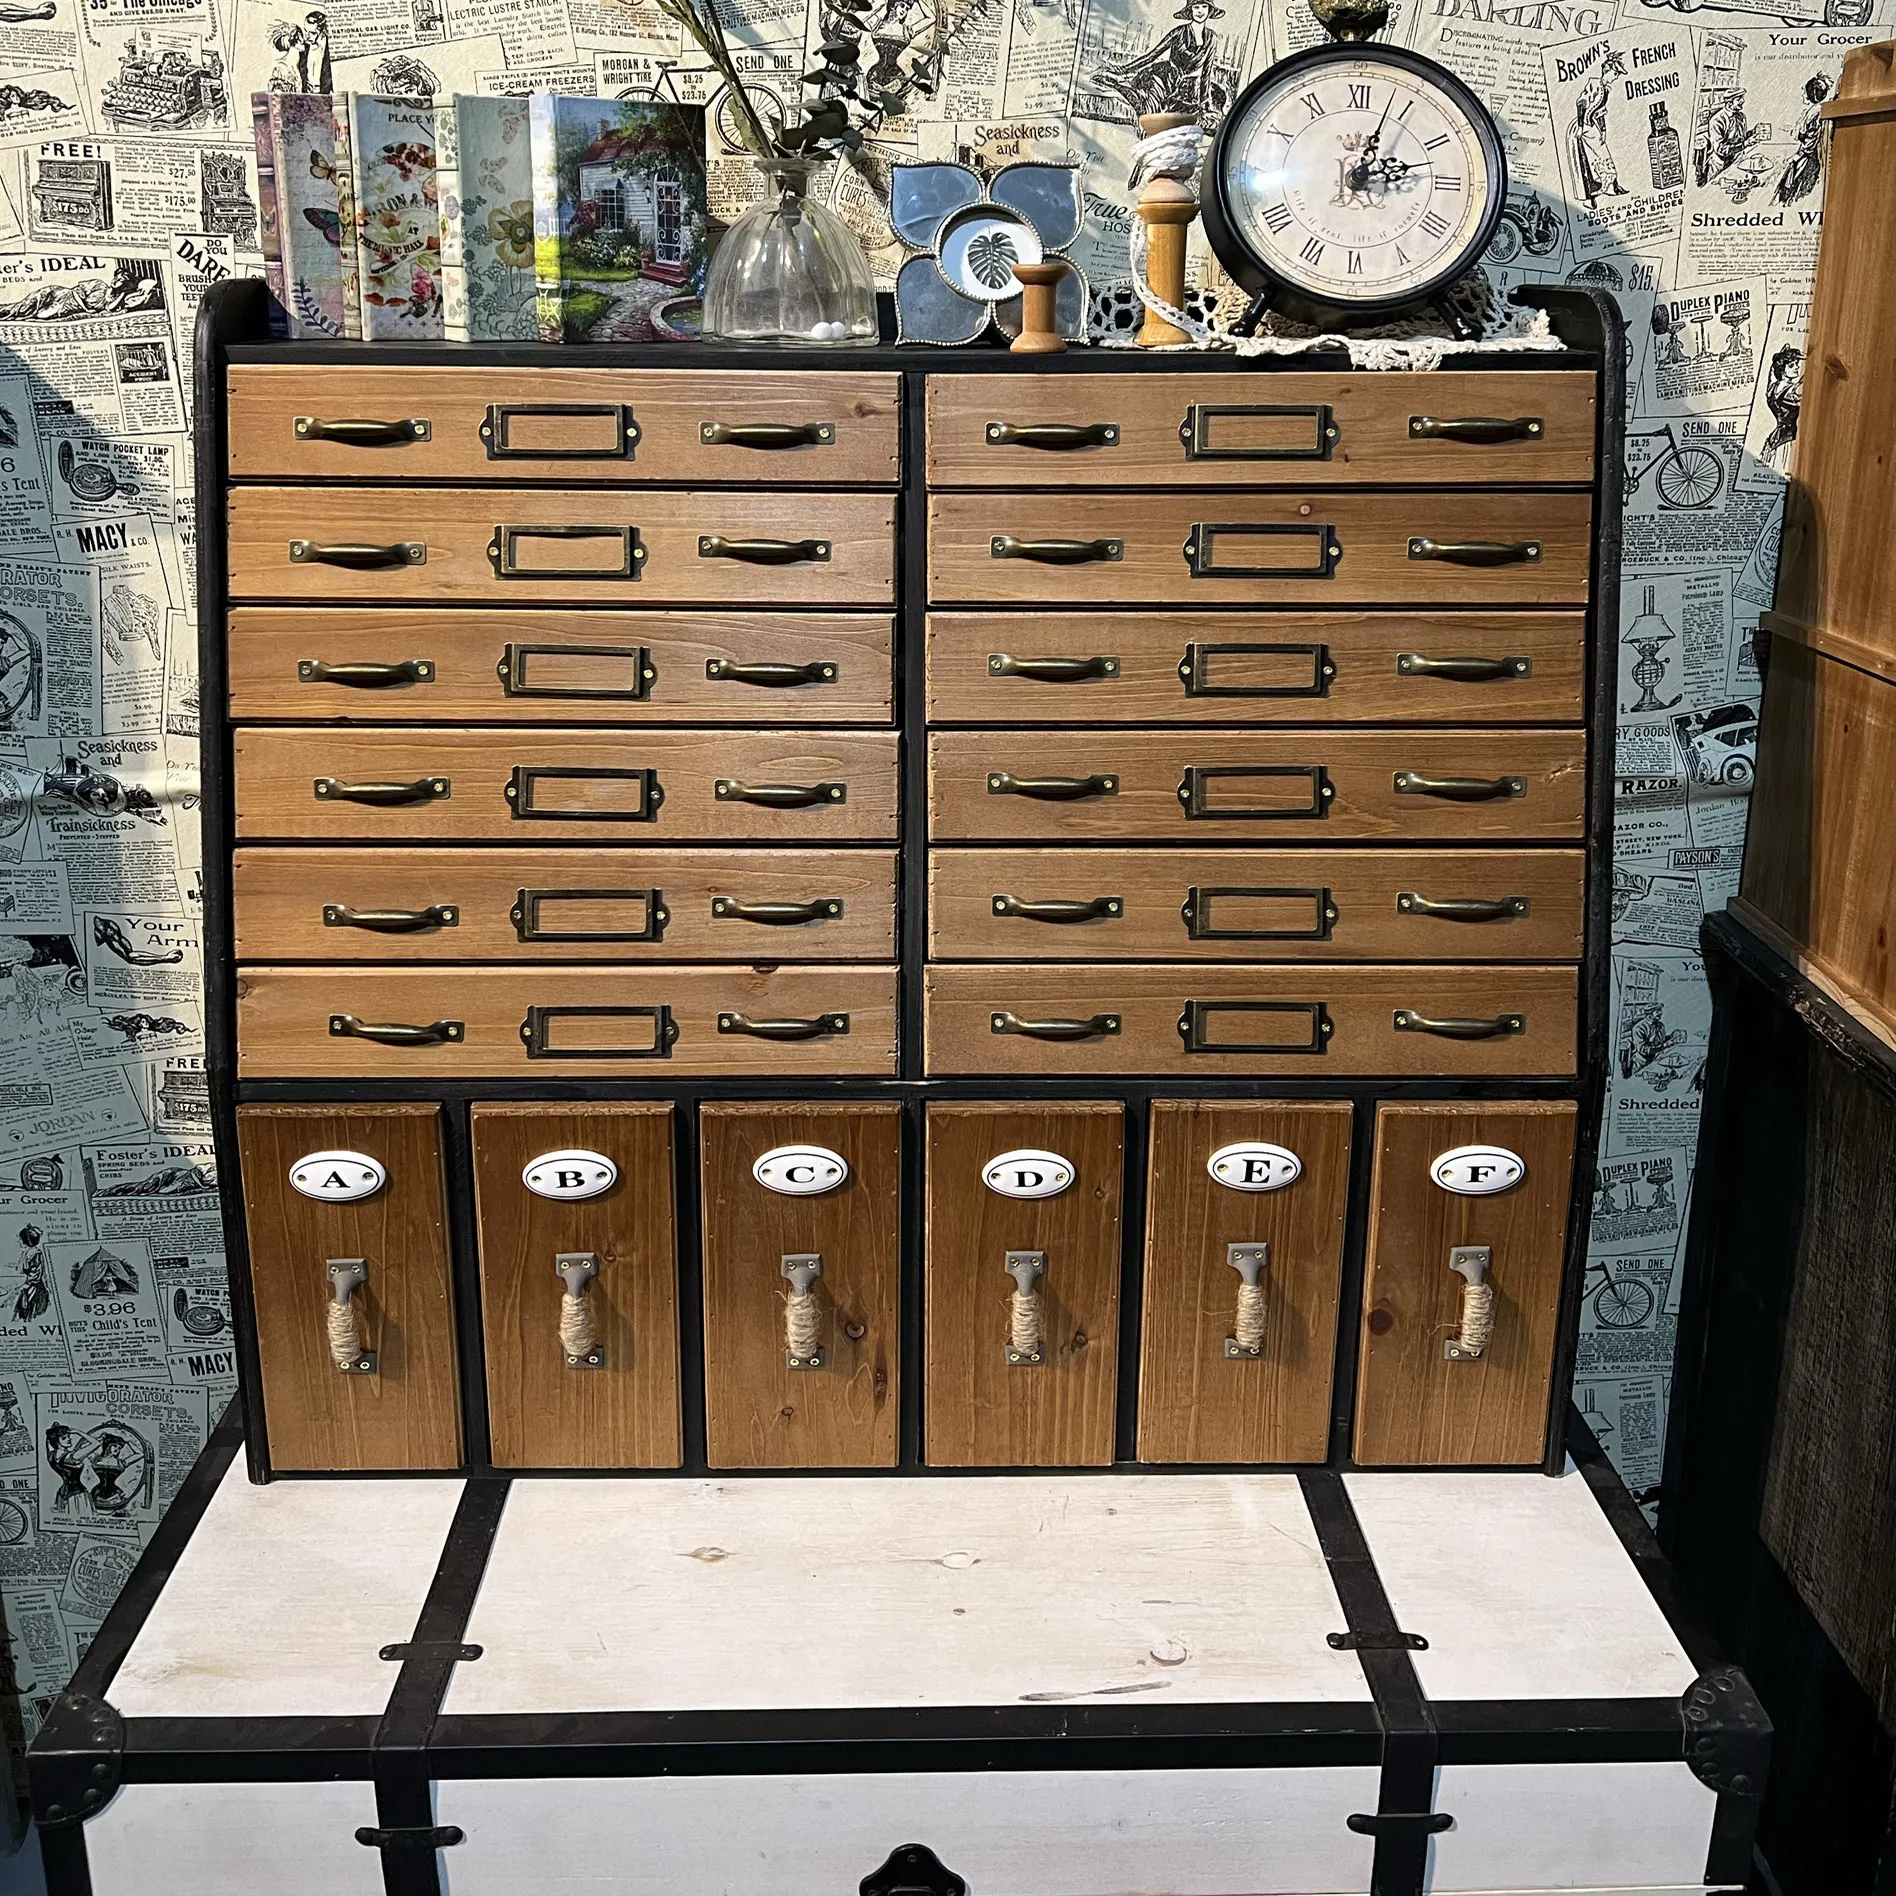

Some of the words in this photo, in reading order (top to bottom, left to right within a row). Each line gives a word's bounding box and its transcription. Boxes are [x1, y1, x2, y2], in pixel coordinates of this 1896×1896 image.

[489, 2, 521, 14] LUSTRE
[1769, 34, 1807, 45] Your
[1817, 33, 1872, 44] Grocer
[1555, 40, 1611, 83] BROWN'S
[1632, 42, 1676, 68] FRENCH
[602, 59, 639, 71] MORGAN
[643, 58, 651, 70] &
[736, 56, 764, 73] SEND
[774, 55, 794, 68] ONE
[489, 80, 543, 91] ICE-CREAM
[546, 75, 594, 86] FREEZERS
[602, 73, 633, 85] WRIGHT
[637, 72, 652, 82] TIRE
[1625, 72, 1680, 101] DRESSING
[1347, 84, 1371, 109] XII
[1300, 92, 1325, 119] XI
[1397, 100, 1414, 120] I
[388, 113, 422, 123] PLACE
[974, 123, 1060, 147] Seasickness
[1267, 123, 1294, 145] X
[1424, 133, 1450, 151] II
[1510, 131, 1546, 147] Company
[41, 142, 102, 159] FREE!
[996, 140, 1020, 155] and
[1067, 149, 1080, 159] Do
[1085, 150, 1105, 163] You
[169, 168, 196, 179] $27.50
[844, 176, 865, 188] CORN
[1435, 176, 1461, 192] III
[165, 196, 197, 206] $175.00
[841, 184, 868, 207] CURES
[1083, 192, 1128, 220] True
[1577, 205, 1615, 222] LADIES'
[1617, 204, 1632, 212] AND
[1588, 214, 1621, 227] BOOTS
[1626, 208, 1646, 218] AND
[1650, 198, 1684, 211] SHOES
[1262, 203, 1294, 235] VIII
[1691, 212, 1783, 227] Shredded
[204, 247, 228, 255] YOU
[206, 239, 222, 247] DO
[1299, 237, 1326, 266] VII
[1395, 242, 1411, 266] V
[41, 257, 106, 272] IDEAL
[1347, 250, 1363, 274] VI
[178, 274, 212, 283] BRUSH
[1628, 263, 1655, 292] $15.
[1671, 296, 1711, 322] DUPLEX
[1714, 289, 1750, 314] PIANO
[1682, 422, 1710, 438] SEND
[1718, 421, 1737, 434] ONE
[82, 441, 110, 451] WATCH
[113, 444, 144, 454] POCKET
[148, 446, 169, 456] LAMP
[14, 477, 41, 491] Tent
[76, 523, 128, 553] MACY
[131, 538, 137, 546] &
[138, 537, 150, 546] CO.
[57, 567, 91, 577] PATENT
[102, 565, 119, 574] SILK
[121, 561, 152, 571] WAISTS.
[1634, 726, 1670, 738] GOODS
[77, 739, 158, 759] Seasickness
[100, 752, 123, 767] and
[1621, 778, 1683, 795] RAZOR.
[1696, 802, 1725, 815] Jordan
[46, 817, 136, 833] Trainsickness
[1674, 850, 1720, 866] PAYSON'S
[126, 918, 184, 931] Your
[147, 935, 198, 947] Arm
[1618, 1098, 1700, 1110] Shredded
[30, 1111, 97, 1135] JORDAN
[97, 1149, 157, 1161] Foster's
[164, 1145, 216, 1157] IDEAL
[785, 1166, 816, 1184] C
[1241, 1160, 1271, 1184] E
[1466, 1165, 1496, 1183] F
[1602, 1162, 1638, 1183] DUPLEX
[1641, 1157, 1672, 1177] PIANO
[320, 1171, 350, 1188] A
[554, 1171, 586, 1188] B
[1013, 1170, 1044, 1187] D
[20, 1196, 68, 1205] Grocer
[1616, 1259, 1641, 1273] SEND
[1647, 1258, 1665, 1269] ONE
[83, 1301, 136, 1316] $3.96
[92, 1319, 129, 1331] Child's
[133, 1317, 158, 1329] Tent
[188, 1352, 235, 1378] MACY
[106, 1403, 193, 1419] CORSETS.
[12, 1478, 29, 1489] ONE
